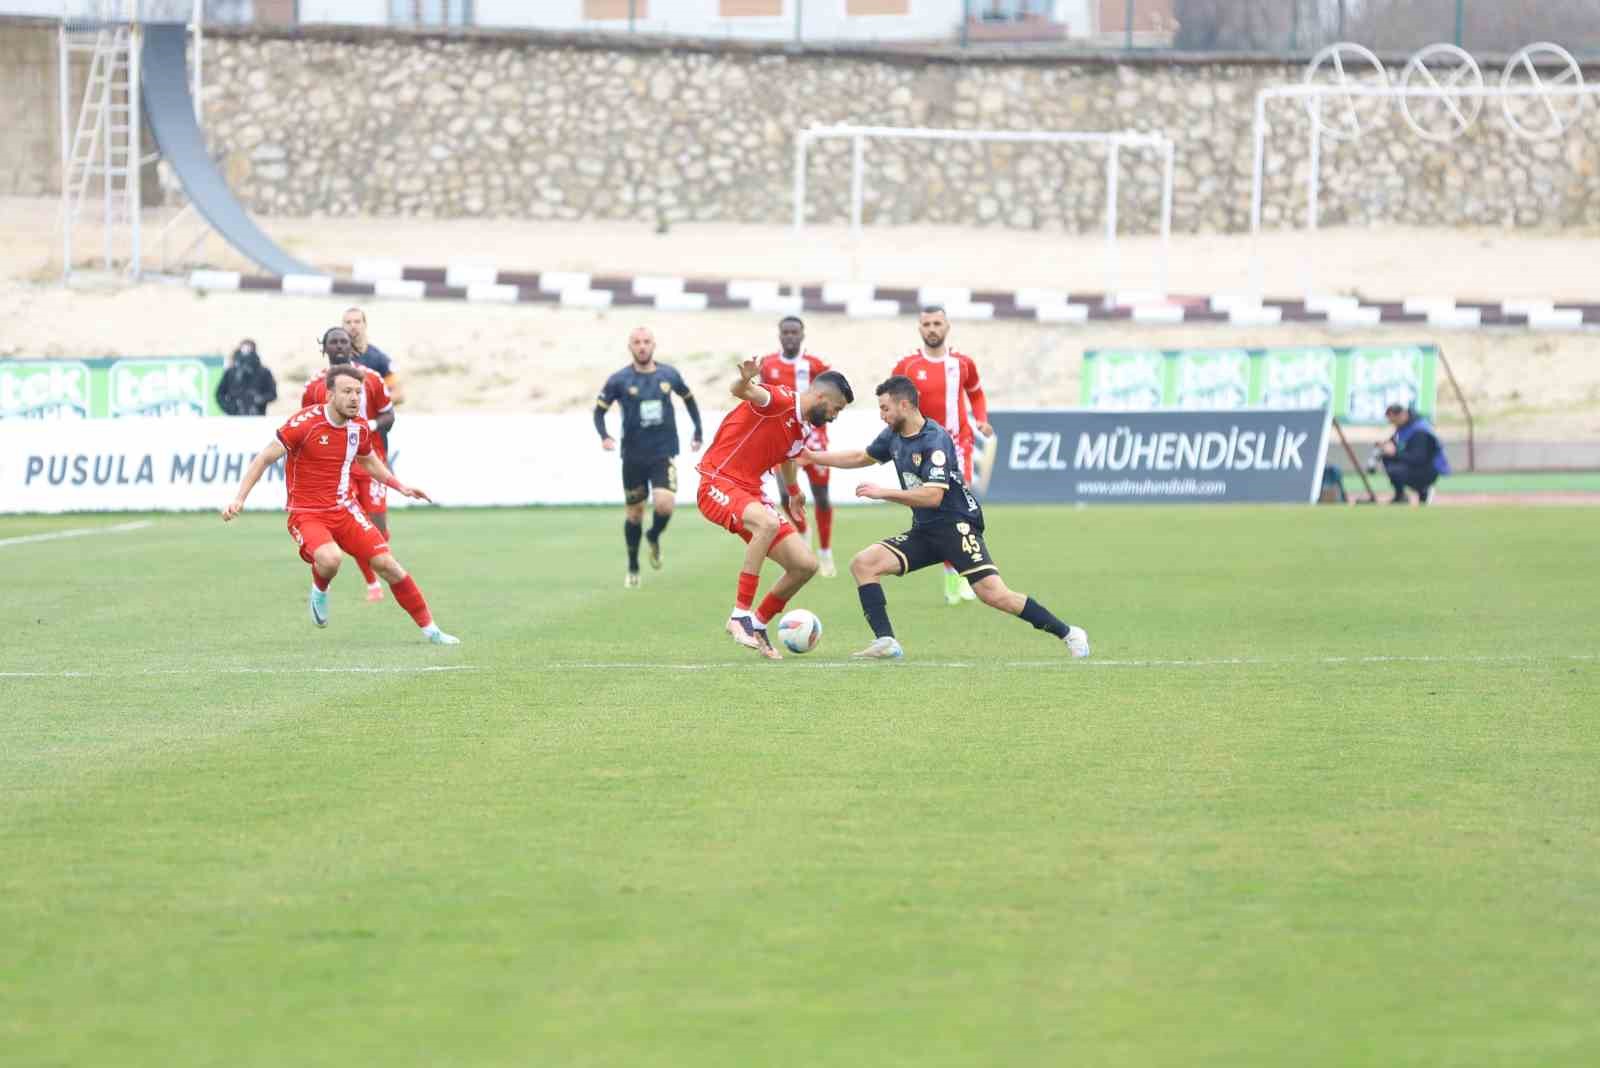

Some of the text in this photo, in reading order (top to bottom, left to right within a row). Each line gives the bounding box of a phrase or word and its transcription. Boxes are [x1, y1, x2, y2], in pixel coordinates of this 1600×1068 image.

[1009, 425, 1307, 470] EZL MÜHENDİSLİK
[25, 454, 154, 486] PUSULA
[961, 533, 981, 554] 45
